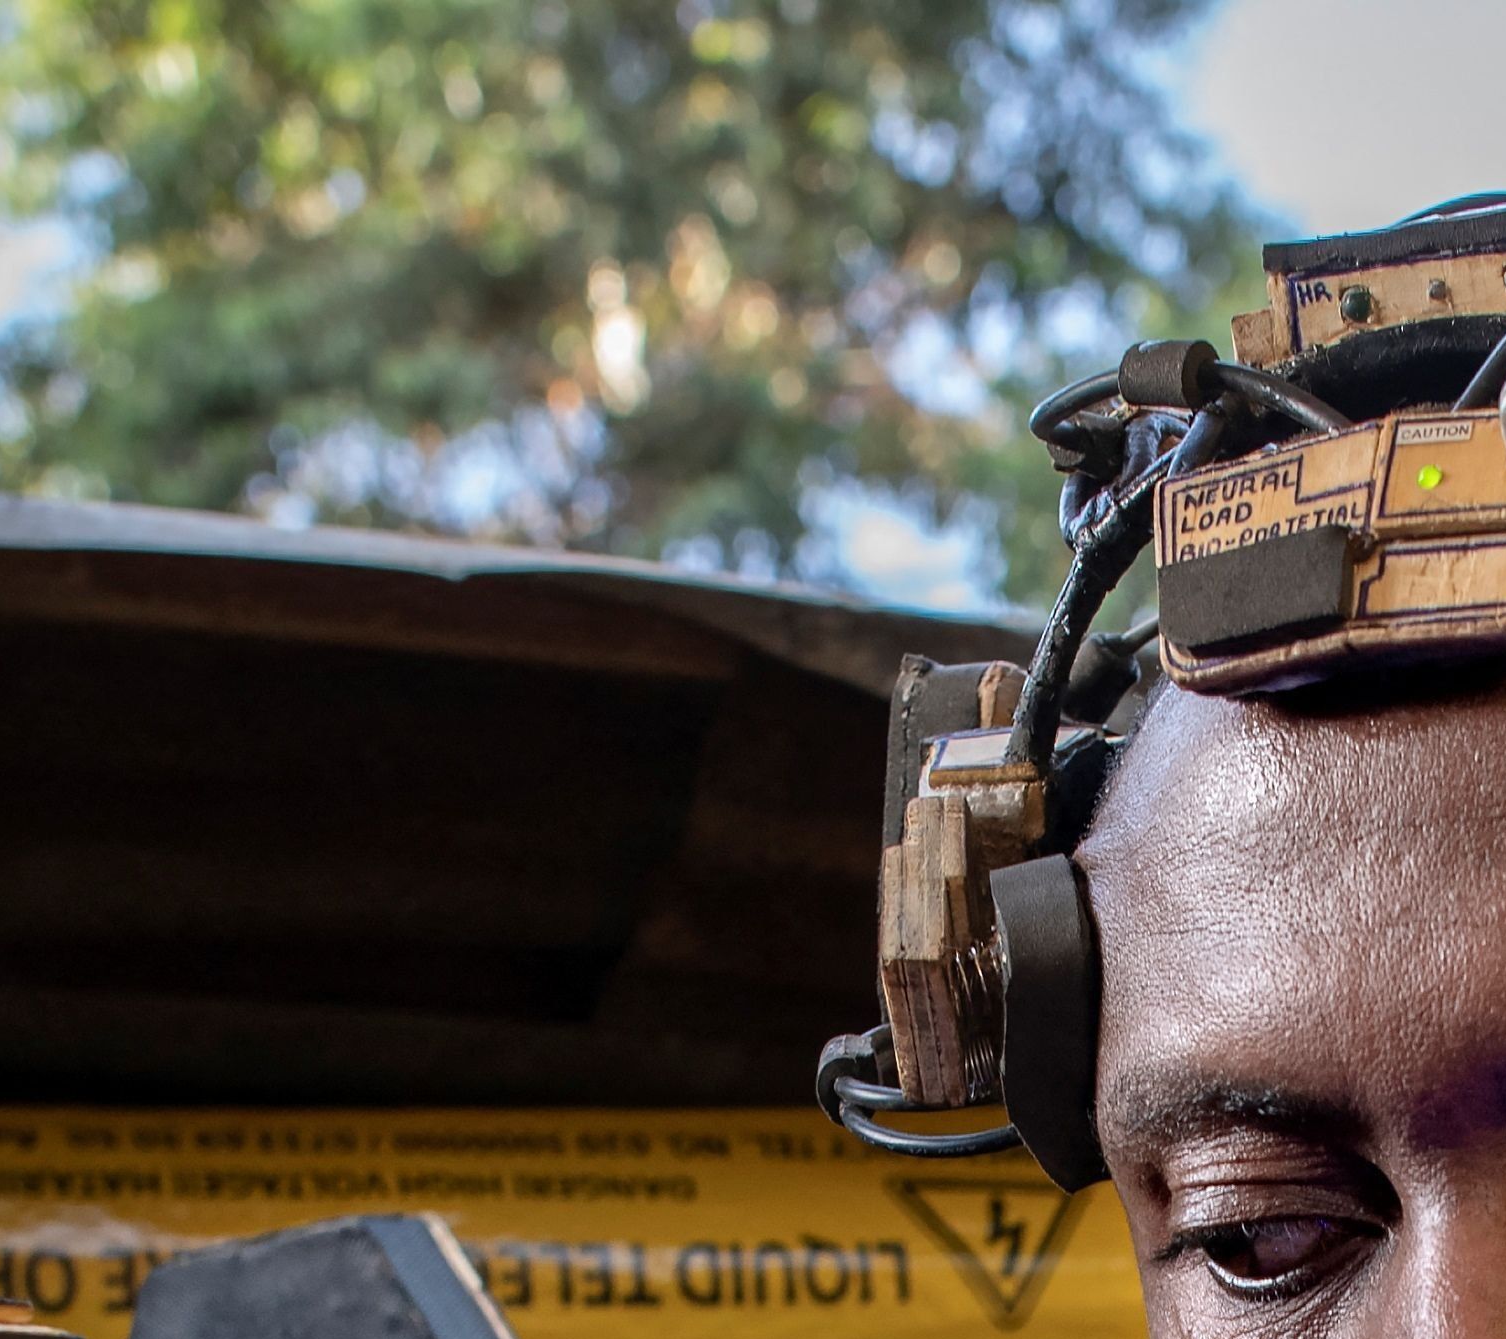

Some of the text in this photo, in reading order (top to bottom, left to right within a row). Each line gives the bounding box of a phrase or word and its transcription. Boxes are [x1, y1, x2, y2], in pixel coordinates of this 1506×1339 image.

[1297, 281, 1332, 306] HR
[1400, 424, 1470, 442] CAUTION
[1184, 470, 1297, 511] NEURAL
[1181, 502, 1253, 534] LOAD
[674, 1235, 913, 1309] LIQUID
